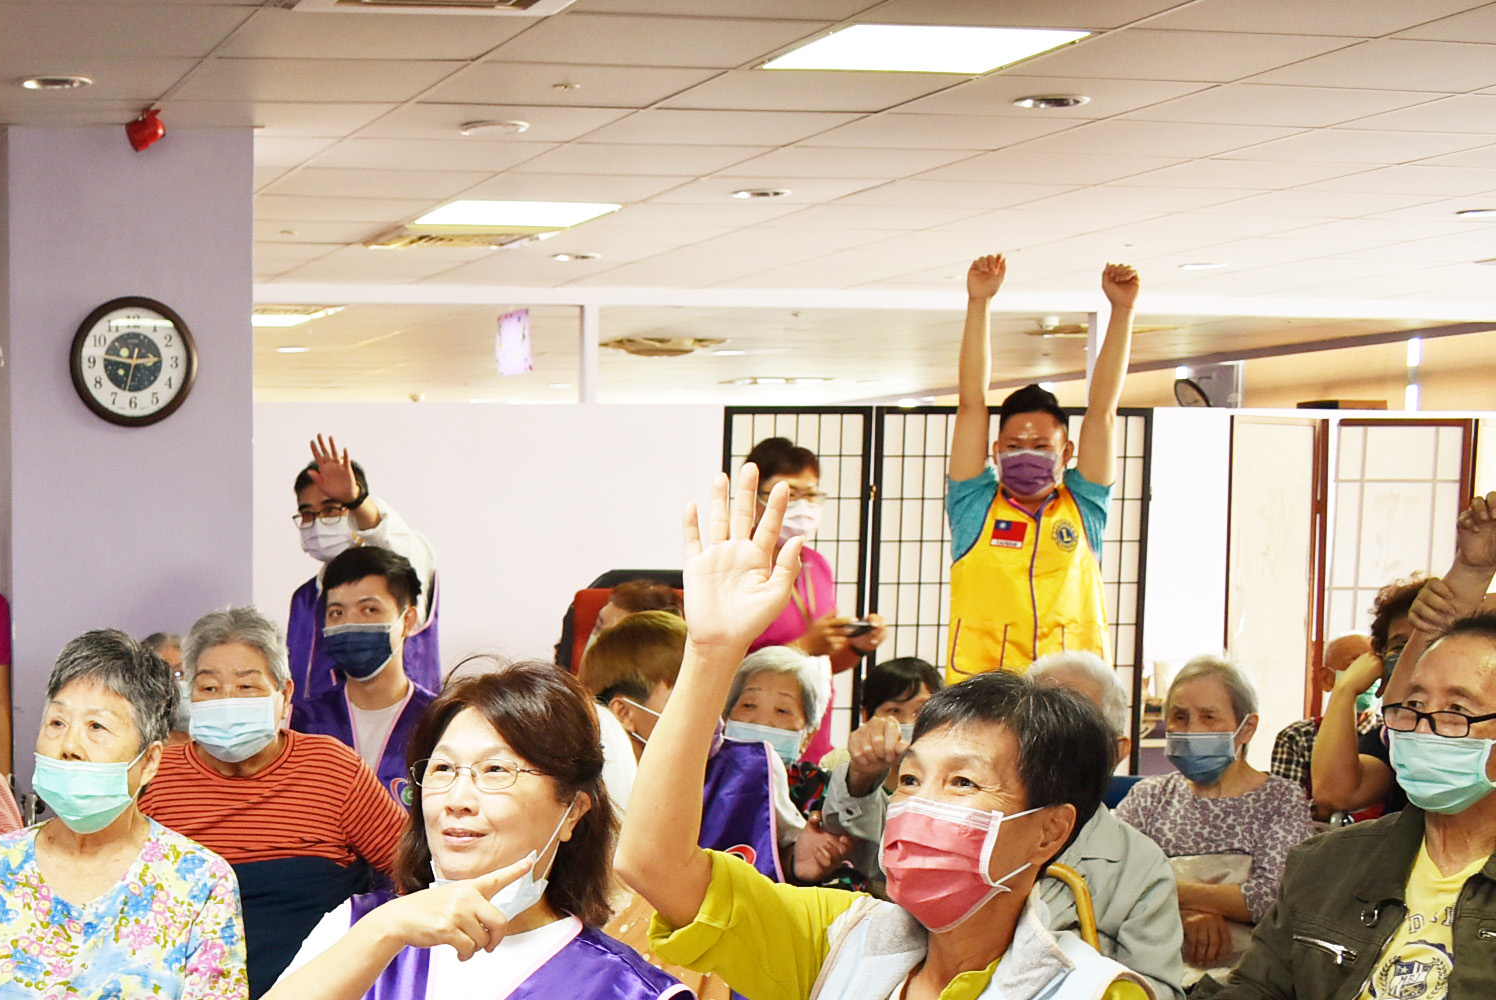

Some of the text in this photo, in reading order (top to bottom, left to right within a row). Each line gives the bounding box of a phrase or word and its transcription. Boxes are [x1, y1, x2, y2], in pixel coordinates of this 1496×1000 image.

[93, 334, 107, 347] 10
[164, 334, 173, 348] 2
[87, 355, 96, 369] 9
[170, 356, 179, 369] 3
[93, 376, 103, 389] 8
[164, 377, 172, 389] 4
[110, 391, 118, 406] 7
[129, 396, 138, 409] 6
[151, 392, 159, 405] 5
